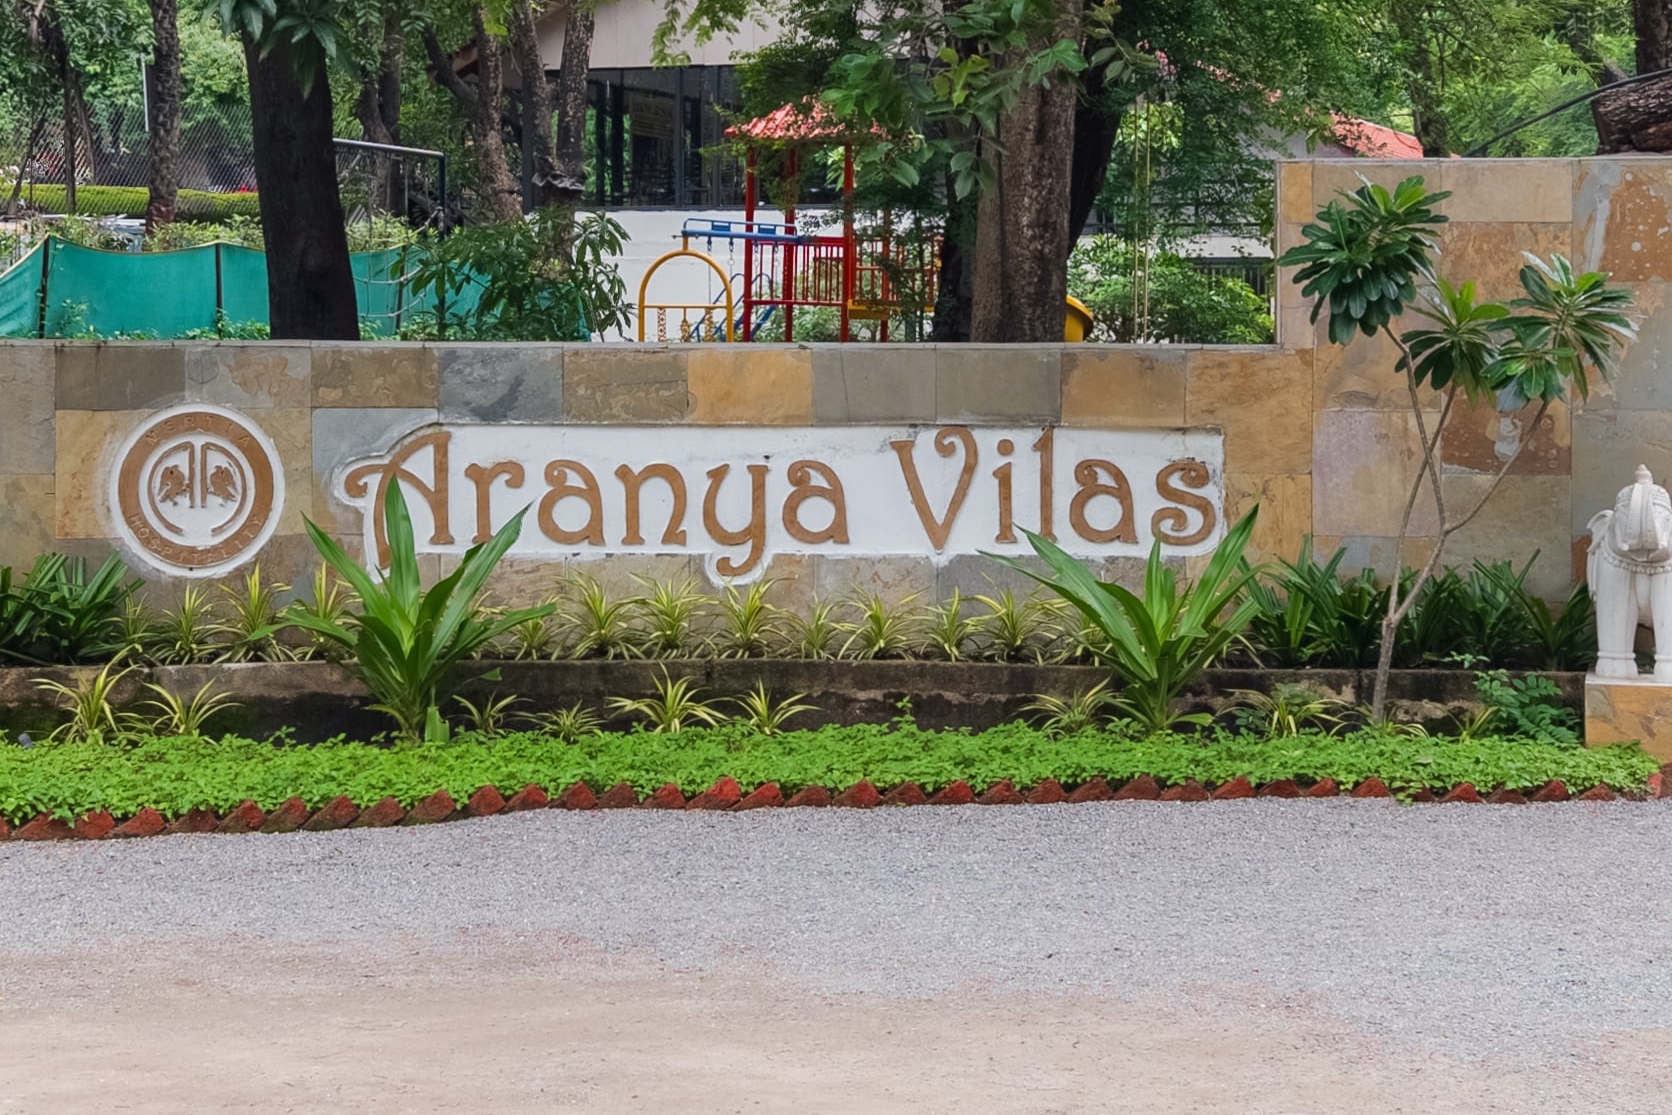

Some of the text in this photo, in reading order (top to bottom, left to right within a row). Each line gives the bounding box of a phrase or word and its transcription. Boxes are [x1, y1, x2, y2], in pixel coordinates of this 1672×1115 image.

[128, 513, 264, 563] HOSPITALITY
[344, 425, 1217, 577] Aranya Vilas
